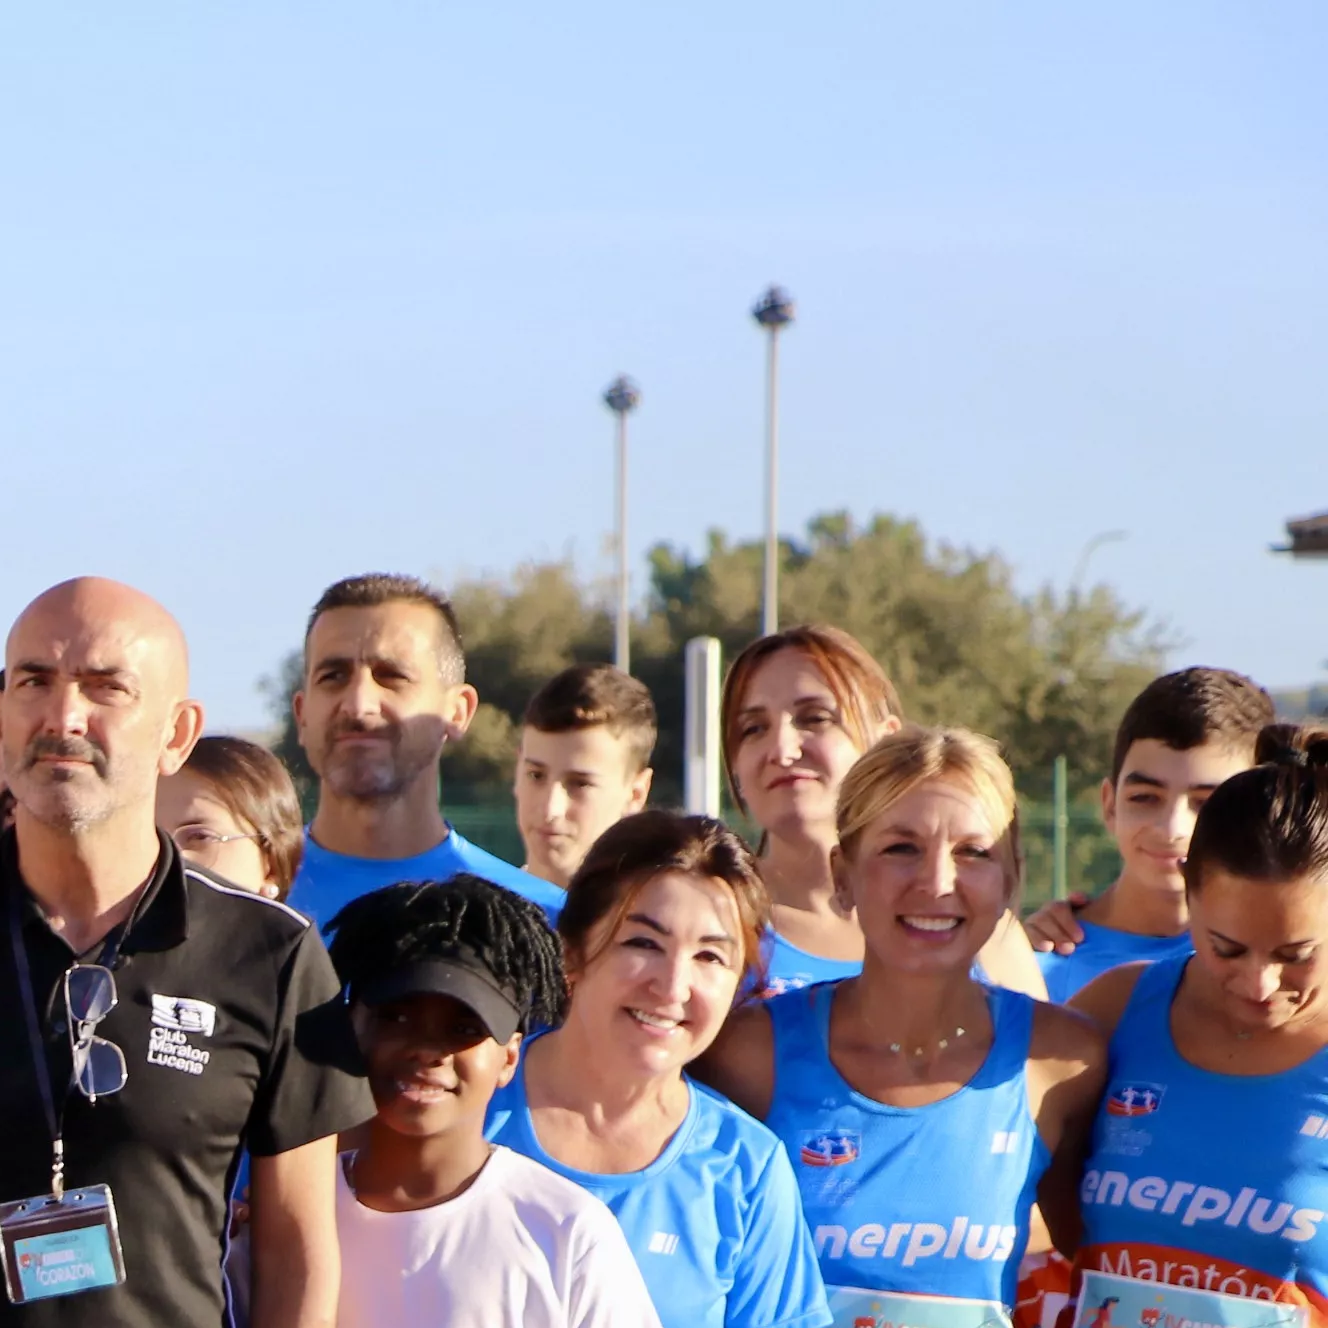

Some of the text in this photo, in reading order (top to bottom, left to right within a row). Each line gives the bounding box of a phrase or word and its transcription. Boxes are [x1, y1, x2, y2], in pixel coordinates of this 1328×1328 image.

[150, 1027, 187, 1045] Club
[147, 1050, 204, 1076] Lucena
[1082, 1169, 1325, 1242] enerplus
[813, 1216, 1020, 1268] nerplus
